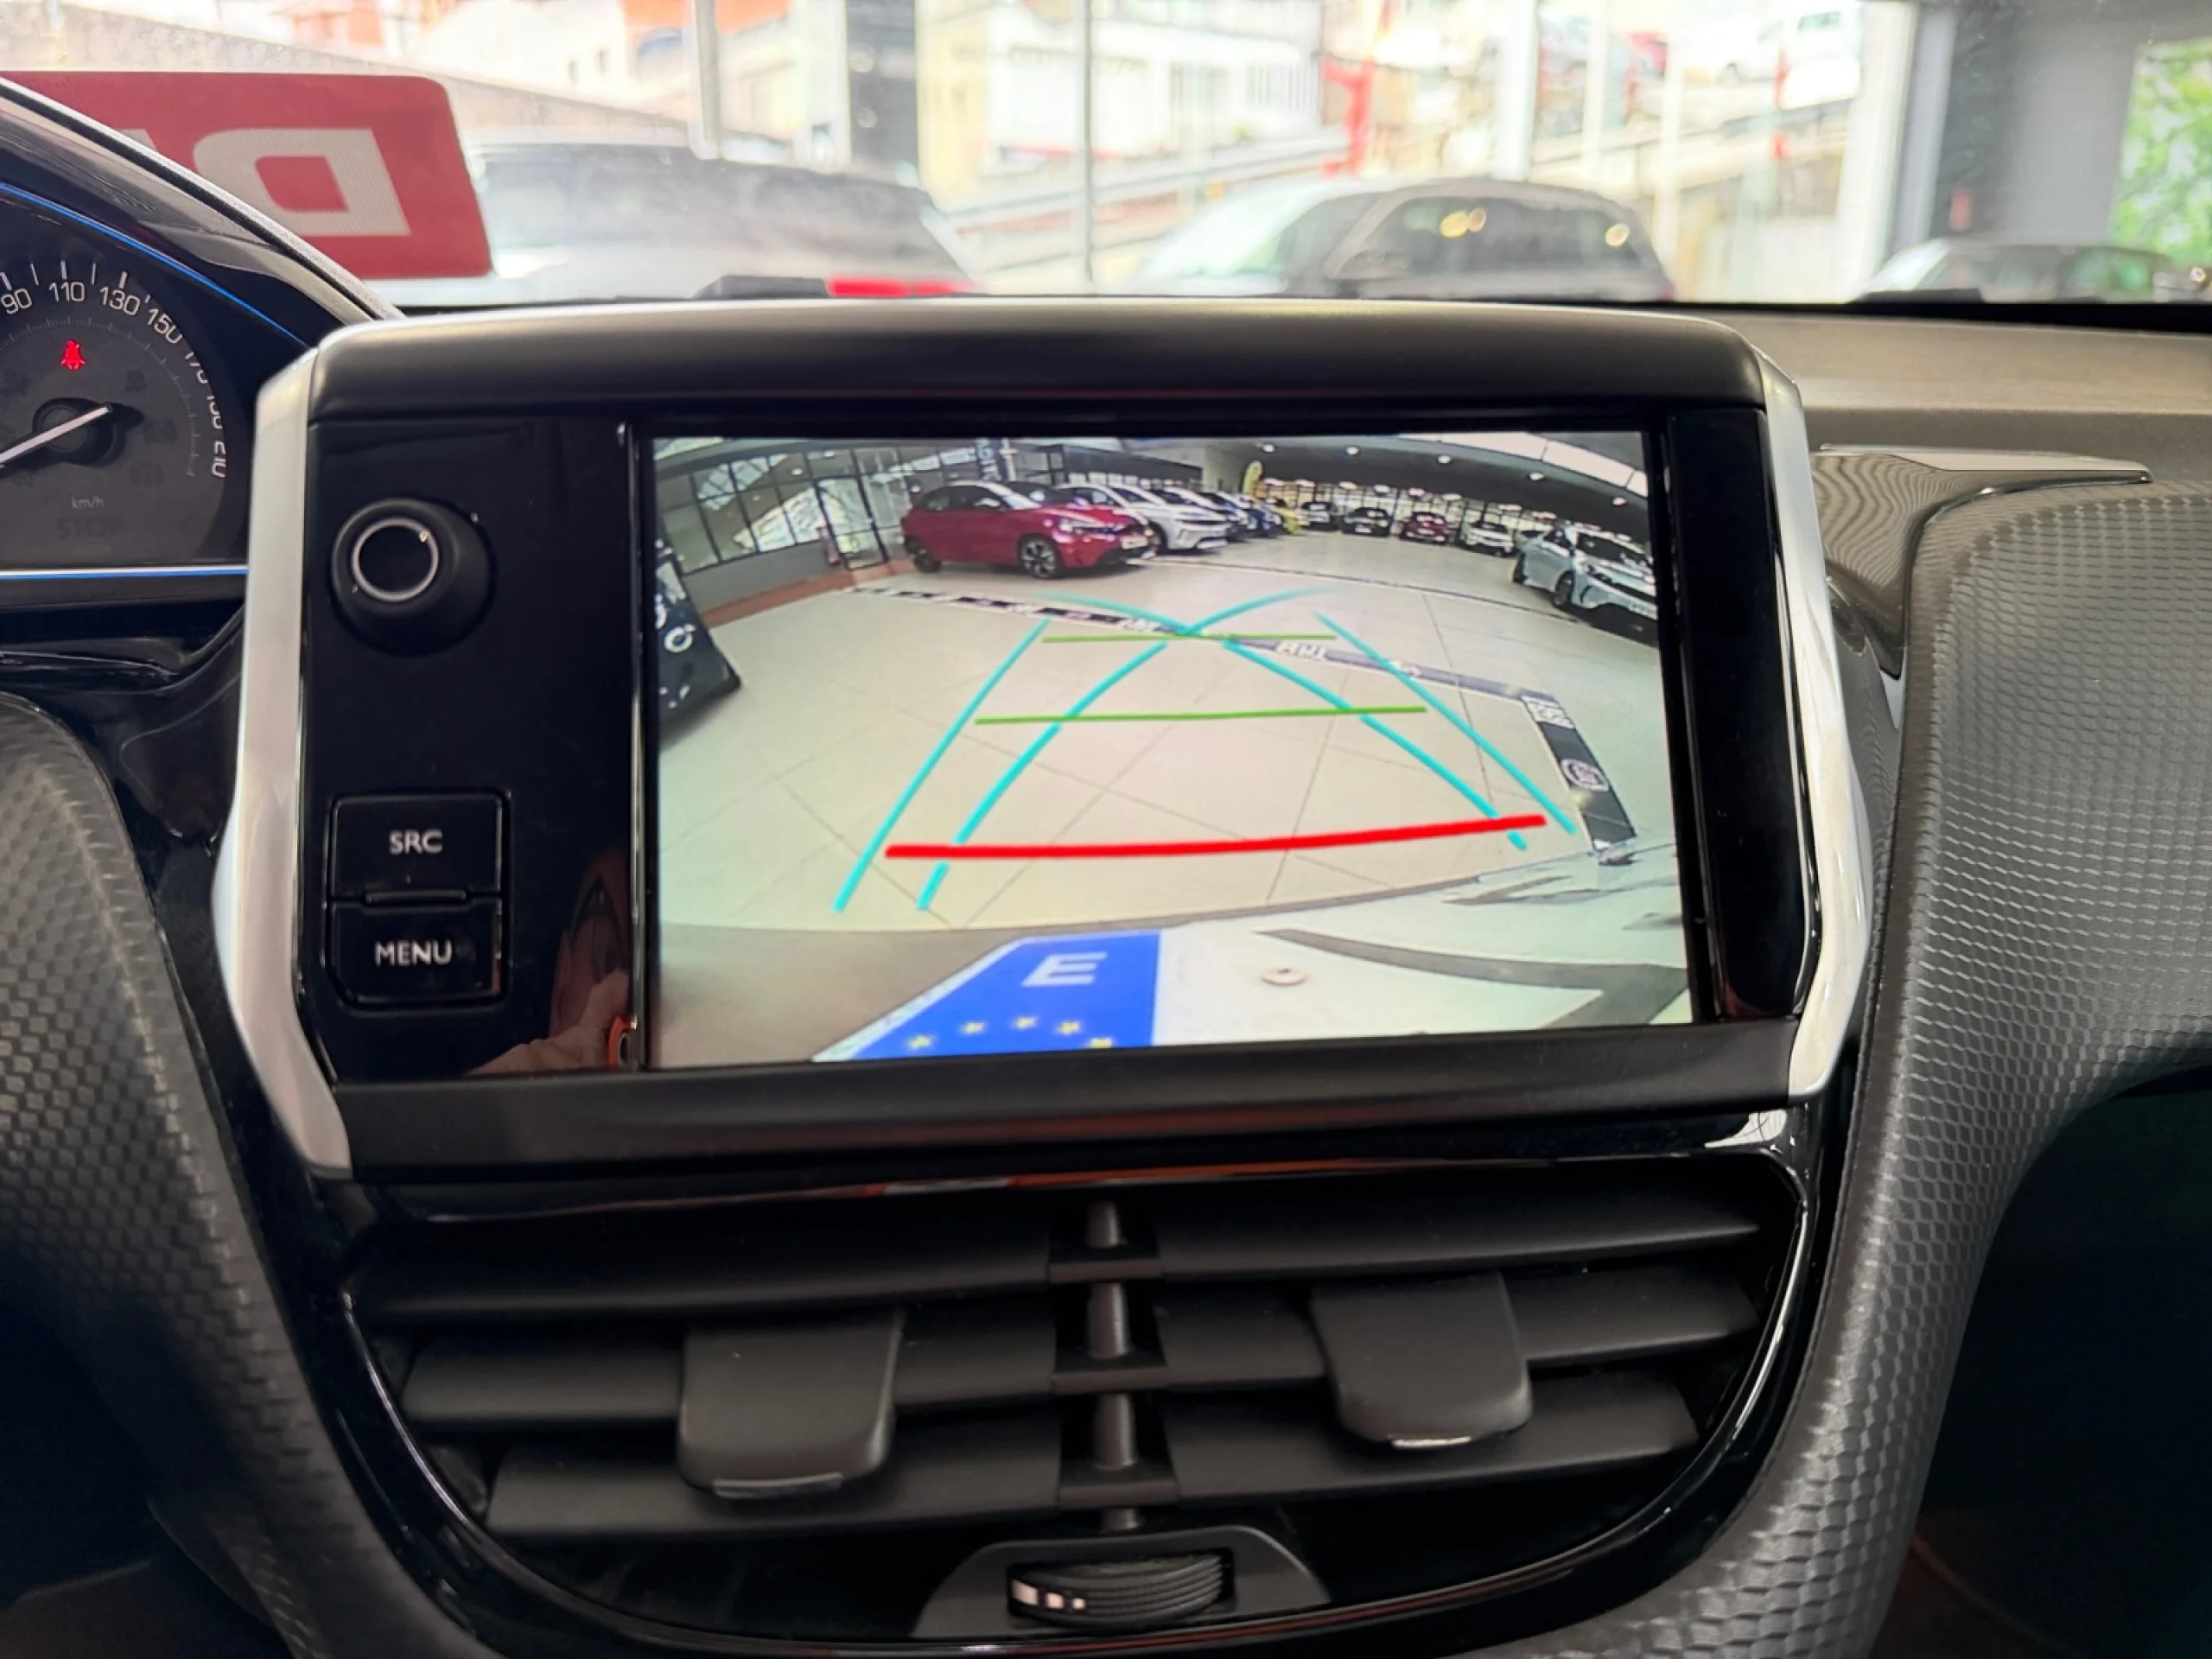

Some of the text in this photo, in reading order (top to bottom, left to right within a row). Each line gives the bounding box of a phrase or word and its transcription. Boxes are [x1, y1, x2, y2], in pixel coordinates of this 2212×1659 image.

[1, 288, 33, 315] 90
[48, 281, 86, 302] 110
[99, 285, 141, 316] 130
[148, 307, 183, 345] 150
[72, 496, 105, 509] km/h
[390, 830, 443, 855] SRC
[374, 939, 453, 967] MENU
[1020, 950, 1109, 988] E
